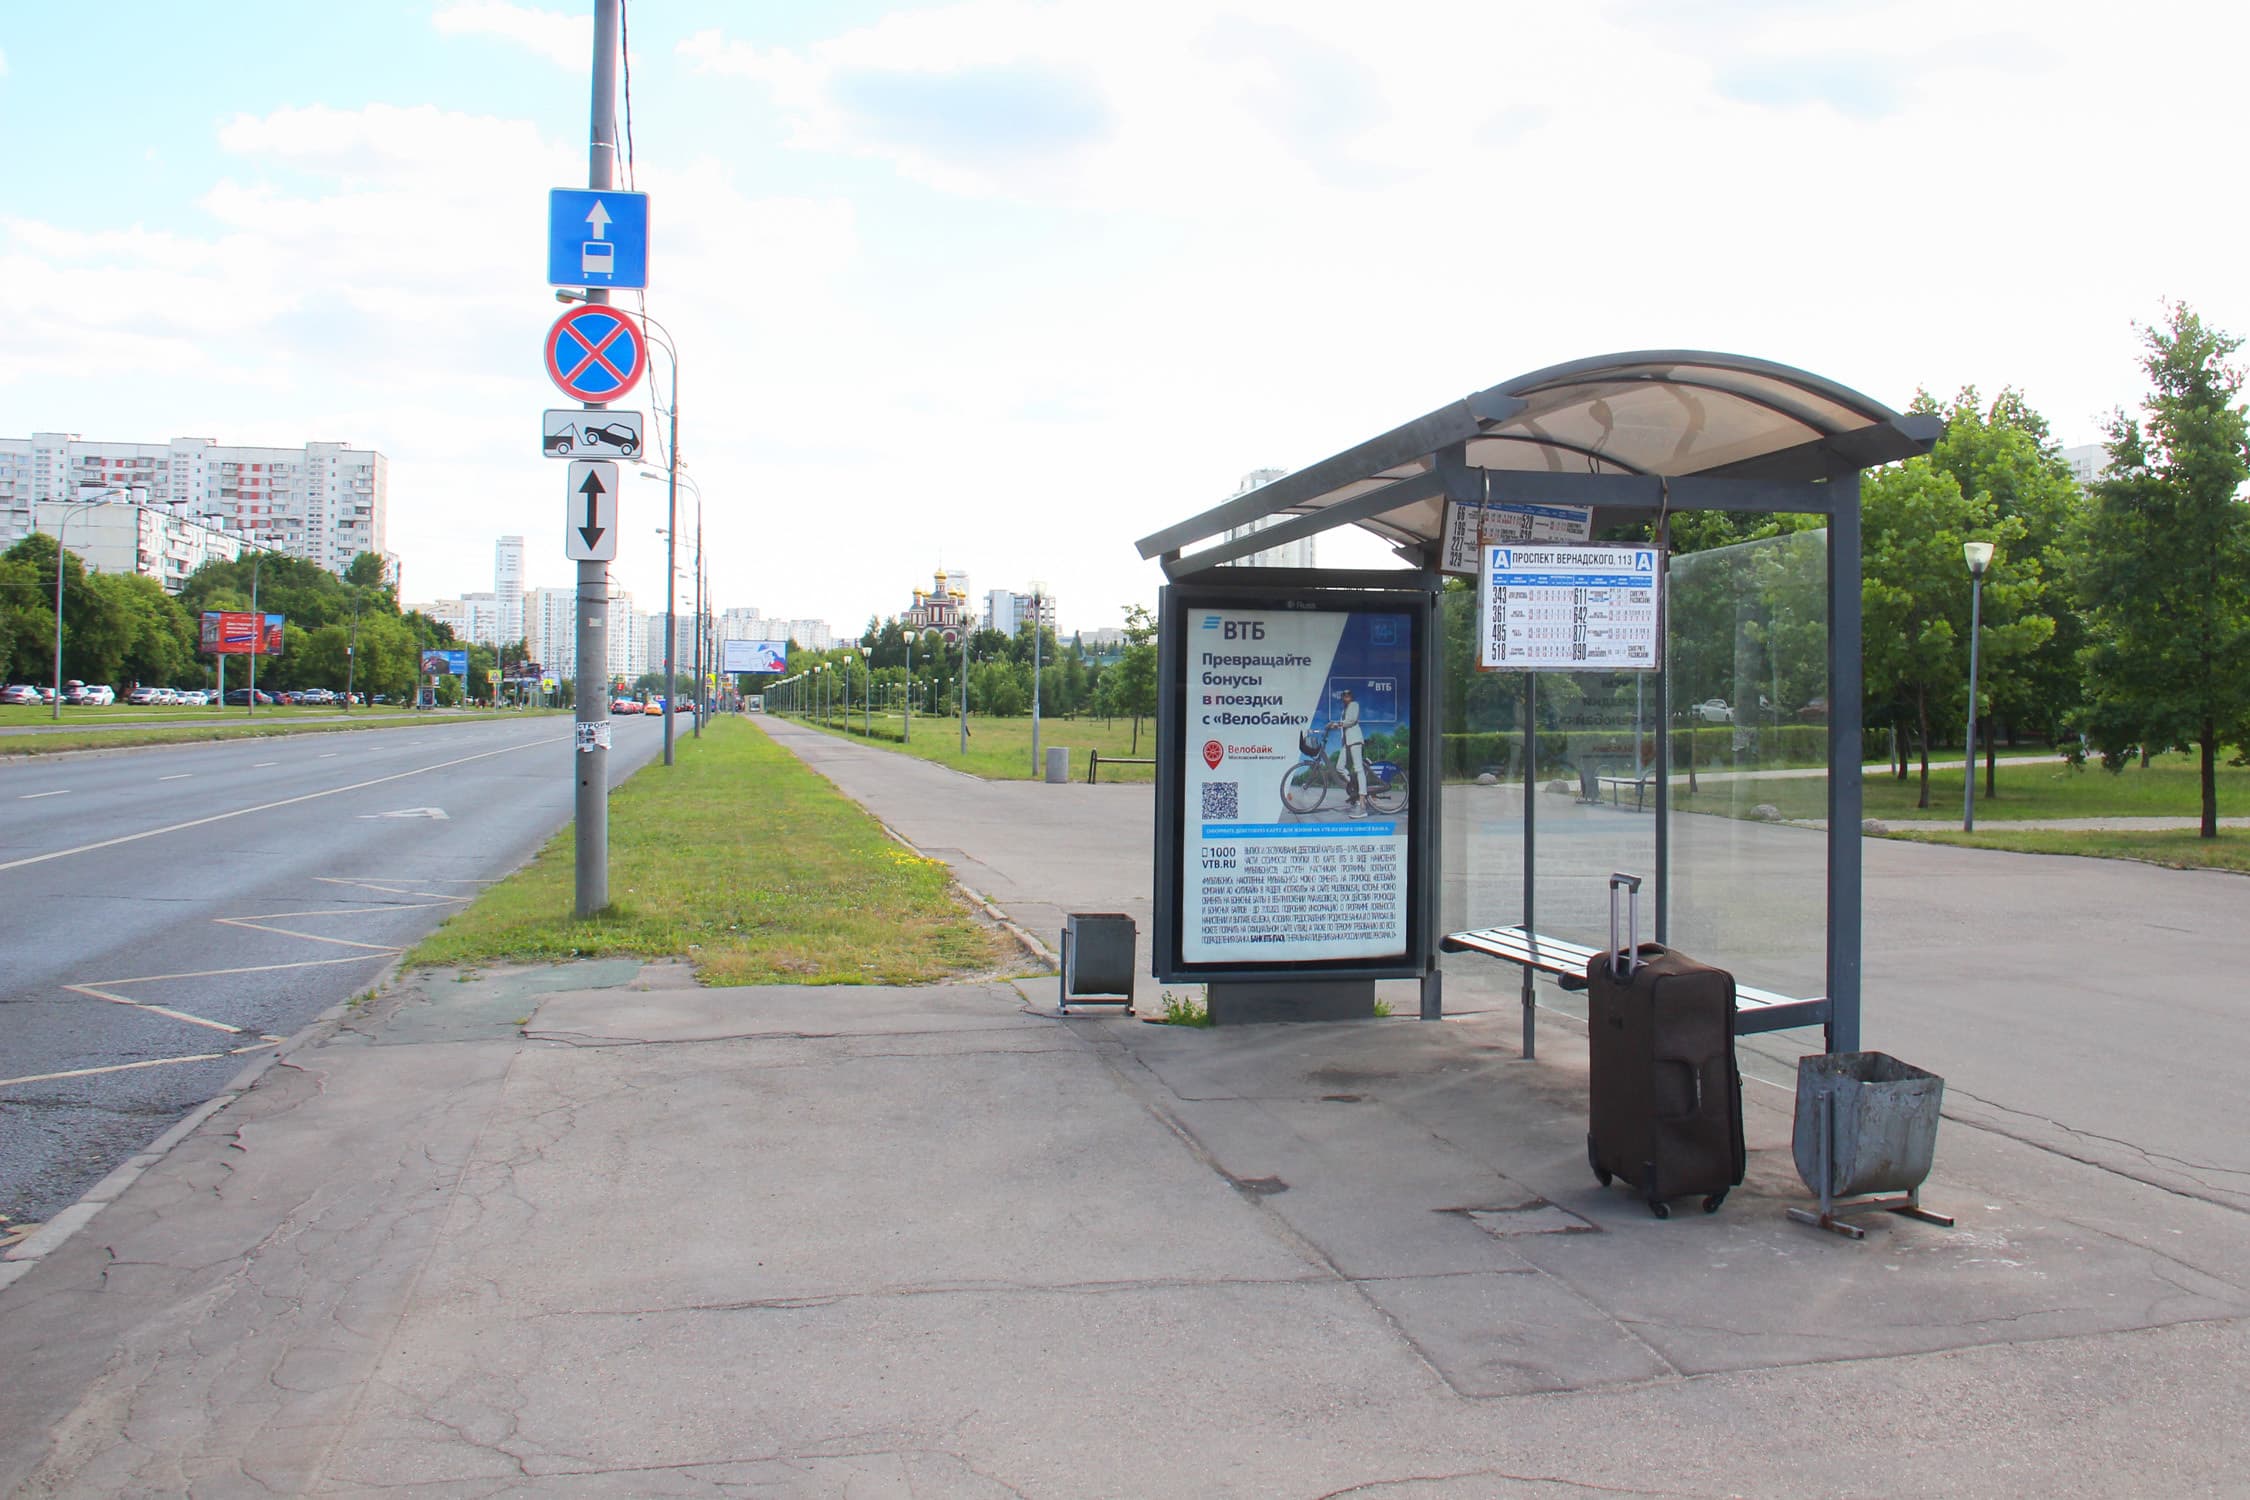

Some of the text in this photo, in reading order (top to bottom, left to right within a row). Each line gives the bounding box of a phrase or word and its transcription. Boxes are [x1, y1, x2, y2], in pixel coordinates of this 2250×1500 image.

[1512, 552, 1632, 566] ПРОСПЕКТ ВЕРНАДСКОГО, 113
[1492, 586, 1506, 604] 343
[1574, 588, 1587, 605] 611
[1492, 605, 1506, 622] 361
[1574, 606, 1588, 624] 642
[1224, 621, 1266, 640] ВТБ
[1492, 624, 1506, 642] 485
[1574, 625, 1587, 642] 877
[1492, 642, 1506, 660] 518
[1572, 644, 1586, 660] 890
[1202, 652, 1312, 669] Превращайте
[1202, 672, 1262, 689] бонусы
[1375, 682, 1392, 692] ВТБ
[1202, 695, 1283, 708] в поездки
[1202, 712, 1308, 726] с «Велобайк»
[1228, 744, 1272, 754] Велобайк
[1210, 847, 1236, 858] 1000
[1202, 860, 1236, 869] VTB.RU
